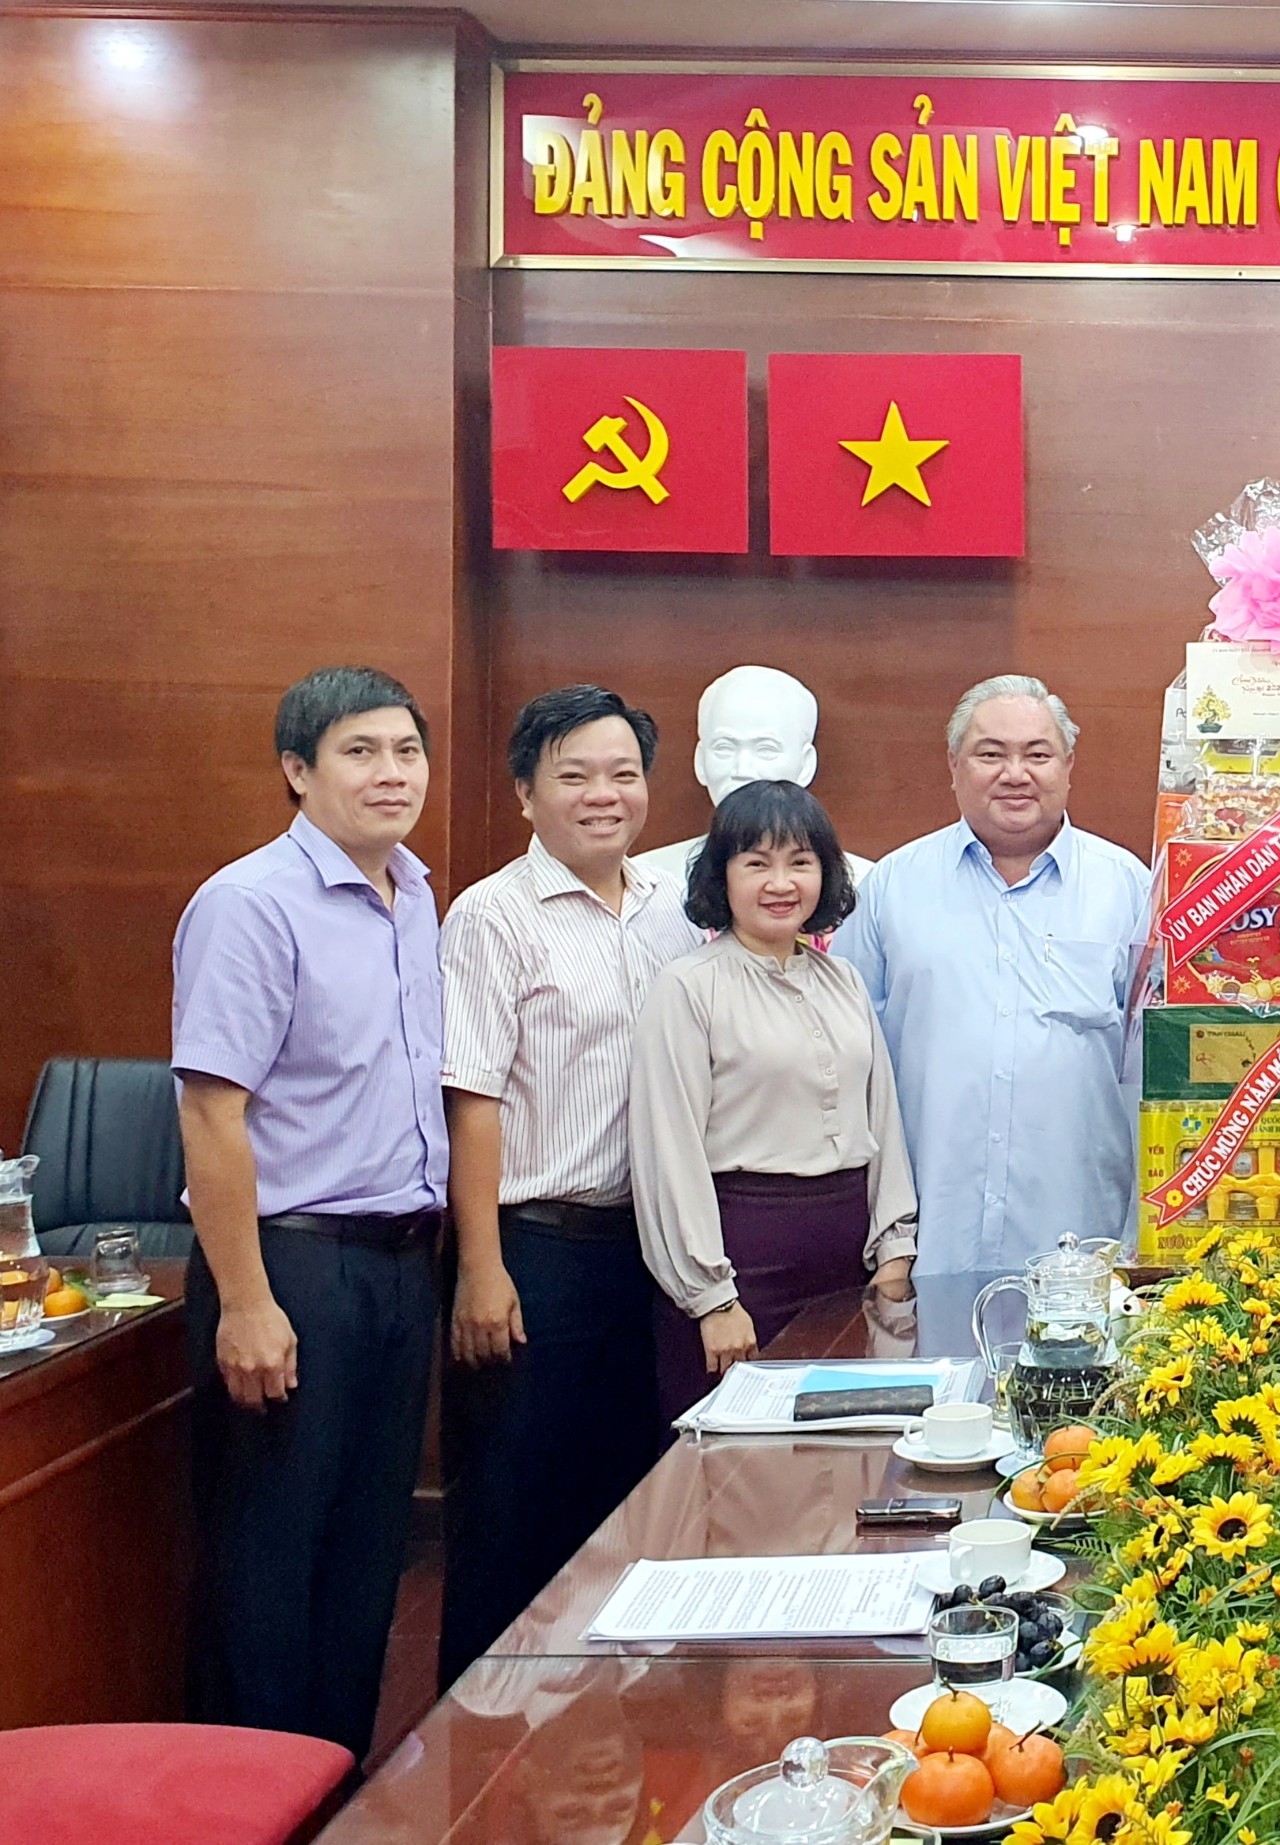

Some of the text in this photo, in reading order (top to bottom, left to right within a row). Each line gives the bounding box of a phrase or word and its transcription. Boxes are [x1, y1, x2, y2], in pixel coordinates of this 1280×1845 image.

[532, 93, 687, 218] ĐẢNG
[701, 107, 855, 239] CỘNG
[868, 94, 979, 222] SẢN
[995, 112, 1120, 246] VIỆT
[1139, 137, 1259, 226] NAM
[1165, 917, 1191, 942] ỦY
[1186, 891, 1220, 927] BAN
[1212, 870, 1254, 907] NHÂN
[1245, 850, 1279, 878] DÂN
[1222, 904, 1280, 933] OSY
[1181, 1154, 1221, 1197] CHÚC
[1211, 1110, 1250, 1160] MỪNG
[1240, 1072, 1276, 1114] NĂM
